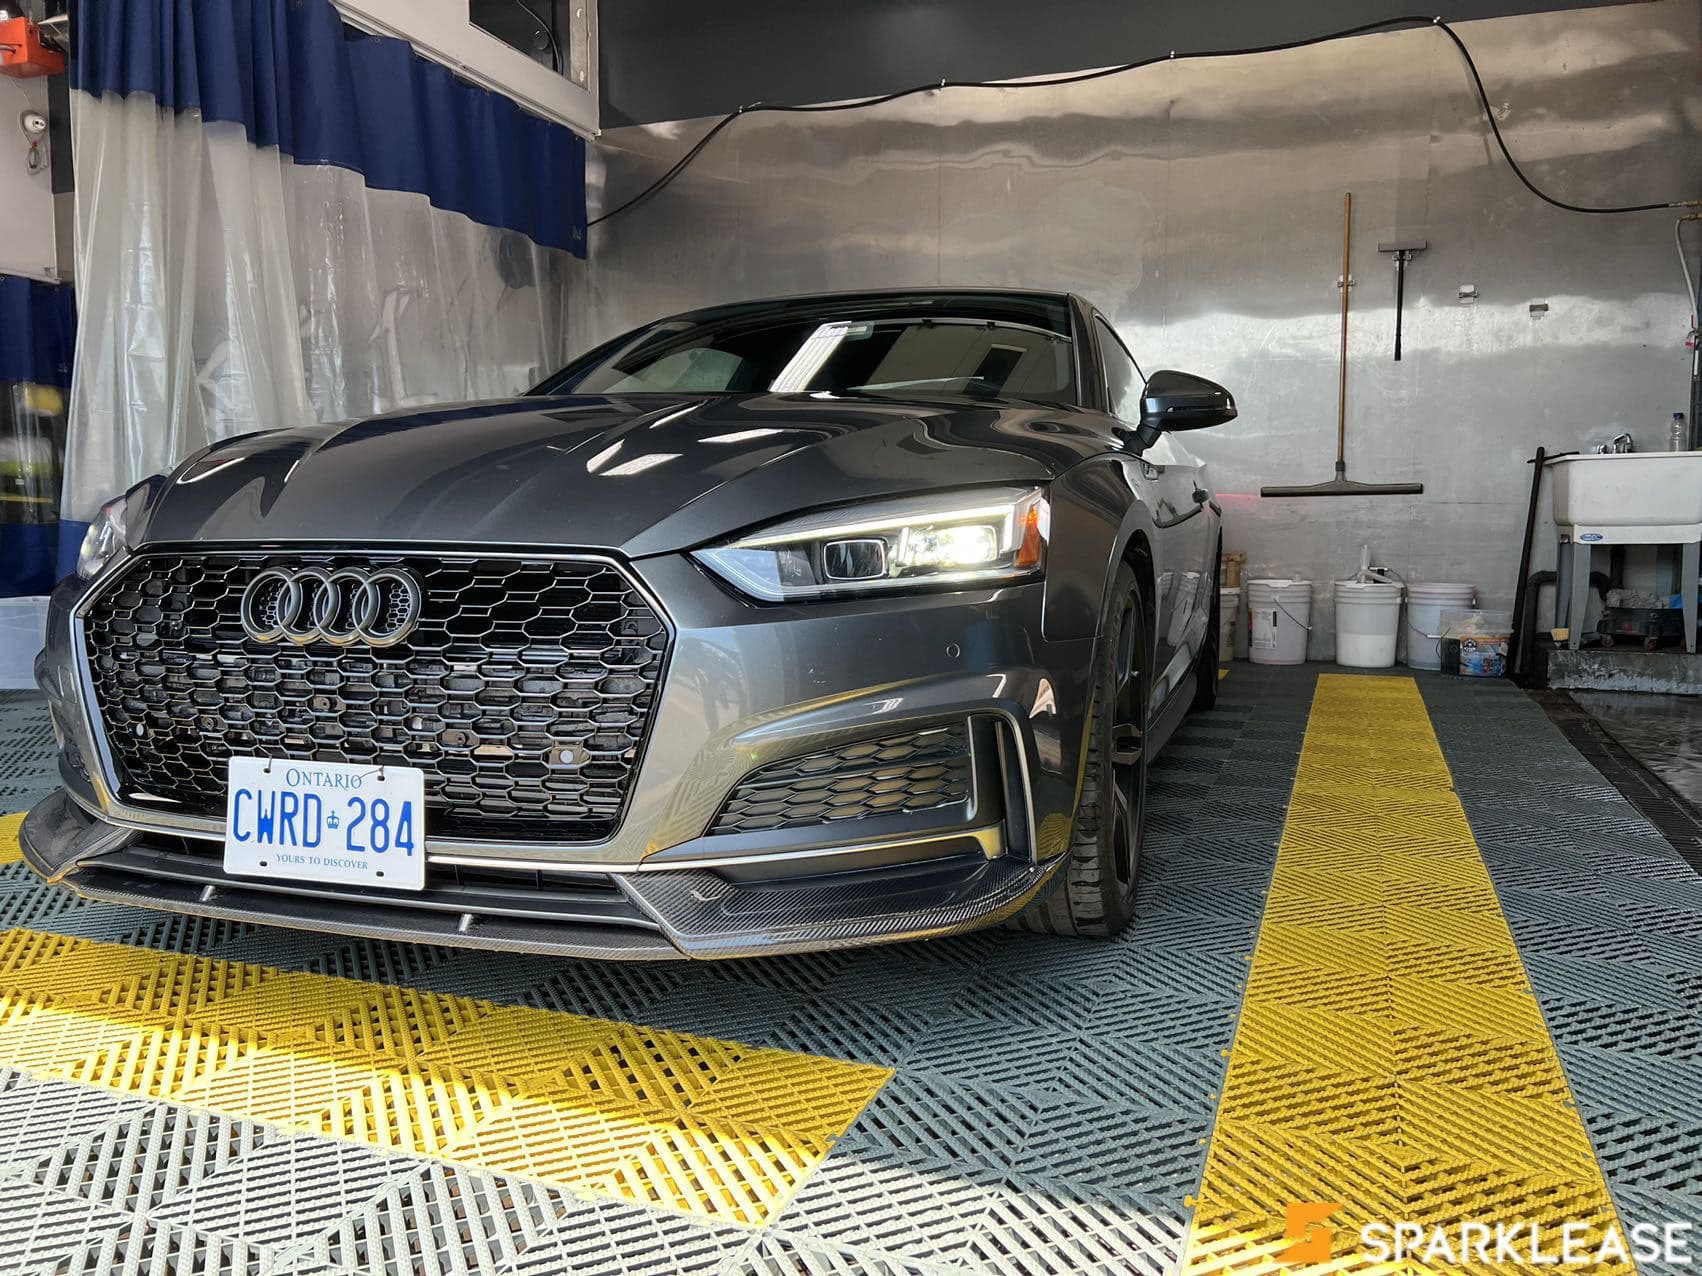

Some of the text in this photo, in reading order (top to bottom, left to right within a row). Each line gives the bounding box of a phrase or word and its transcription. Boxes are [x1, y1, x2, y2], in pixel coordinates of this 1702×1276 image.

[286, 768, 362, 790] ONTARIO
[233, 788, 414, 856] CWRD 284
[276, 854, 368, 870] YOURS TO DISCOVER
